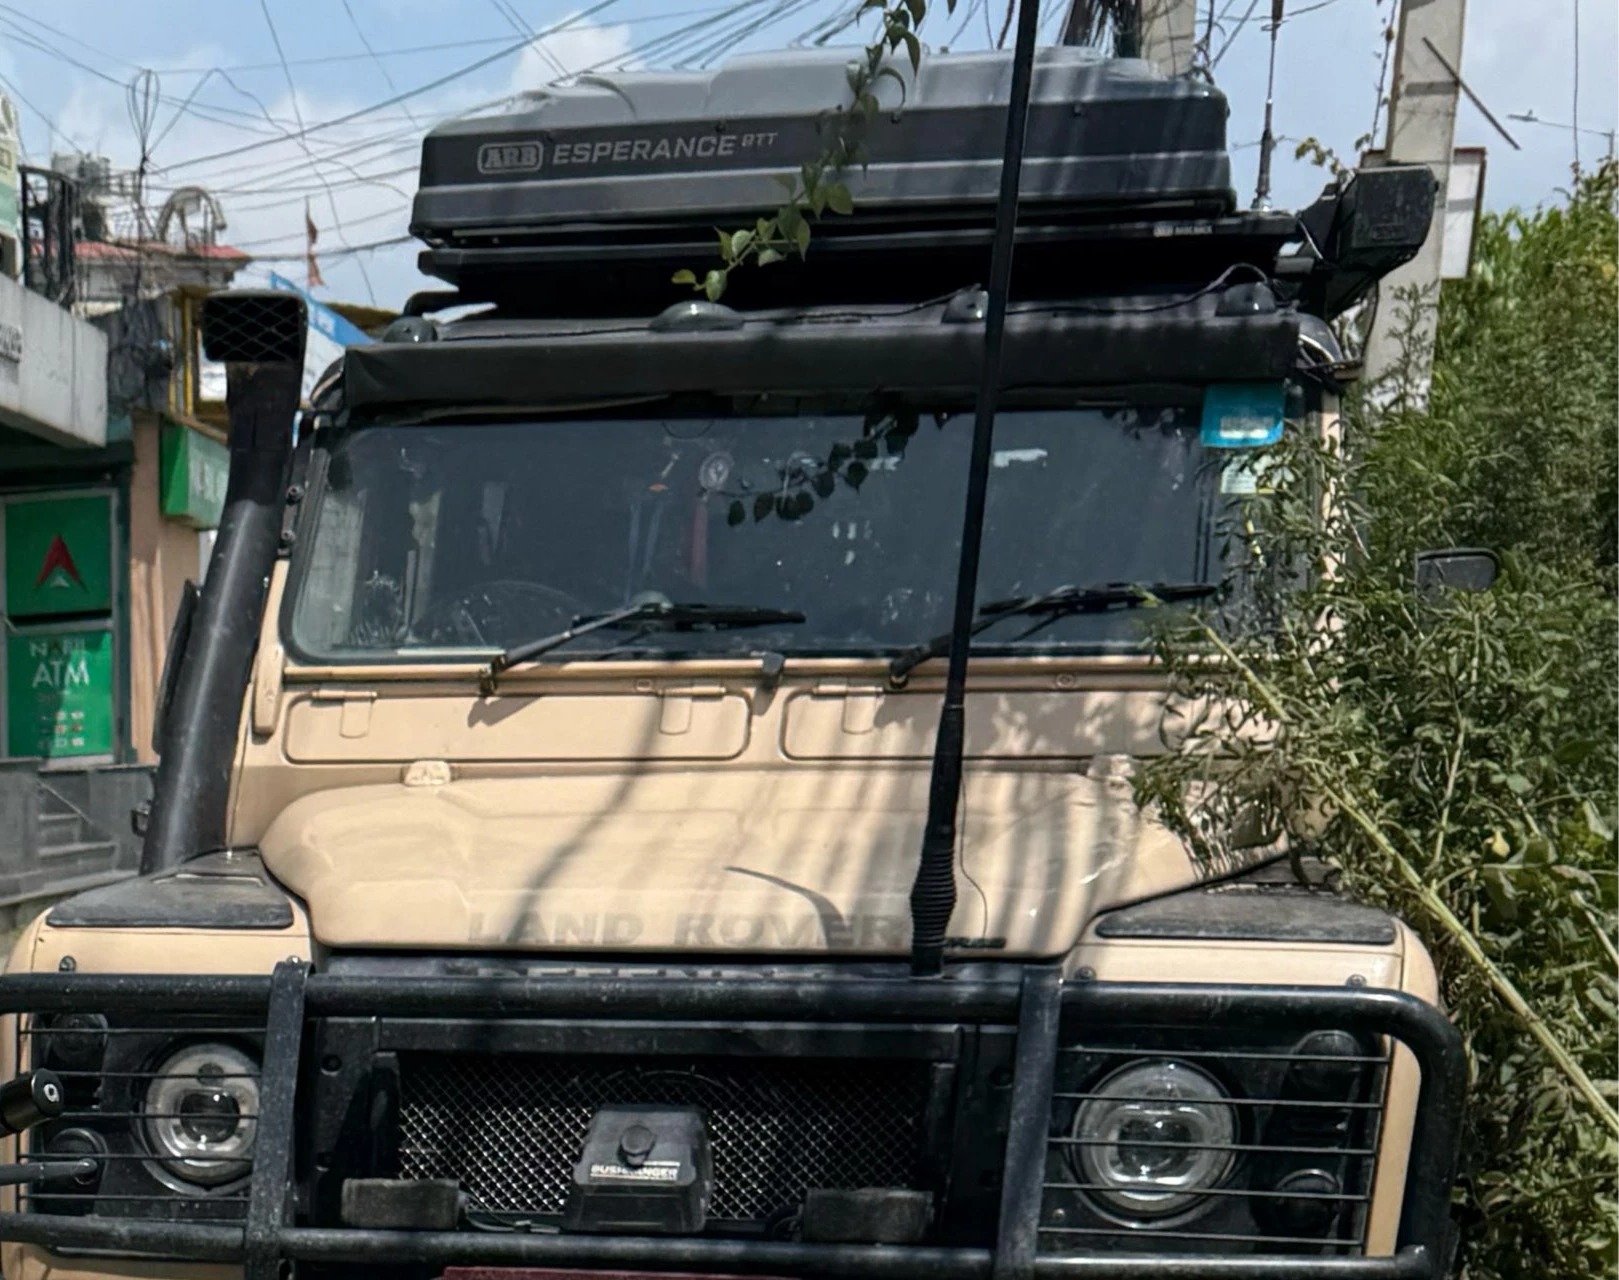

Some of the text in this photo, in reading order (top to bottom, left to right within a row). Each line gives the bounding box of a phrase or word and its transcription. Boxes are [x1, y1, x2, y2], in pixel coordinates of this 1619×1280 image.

[483, 146, 539, 168] ARB
[551, 135, 738, 165] ESPERANCE
[32, 658, 90, 688] ATM
[468, 912, 914, 951] LAND ROVER
